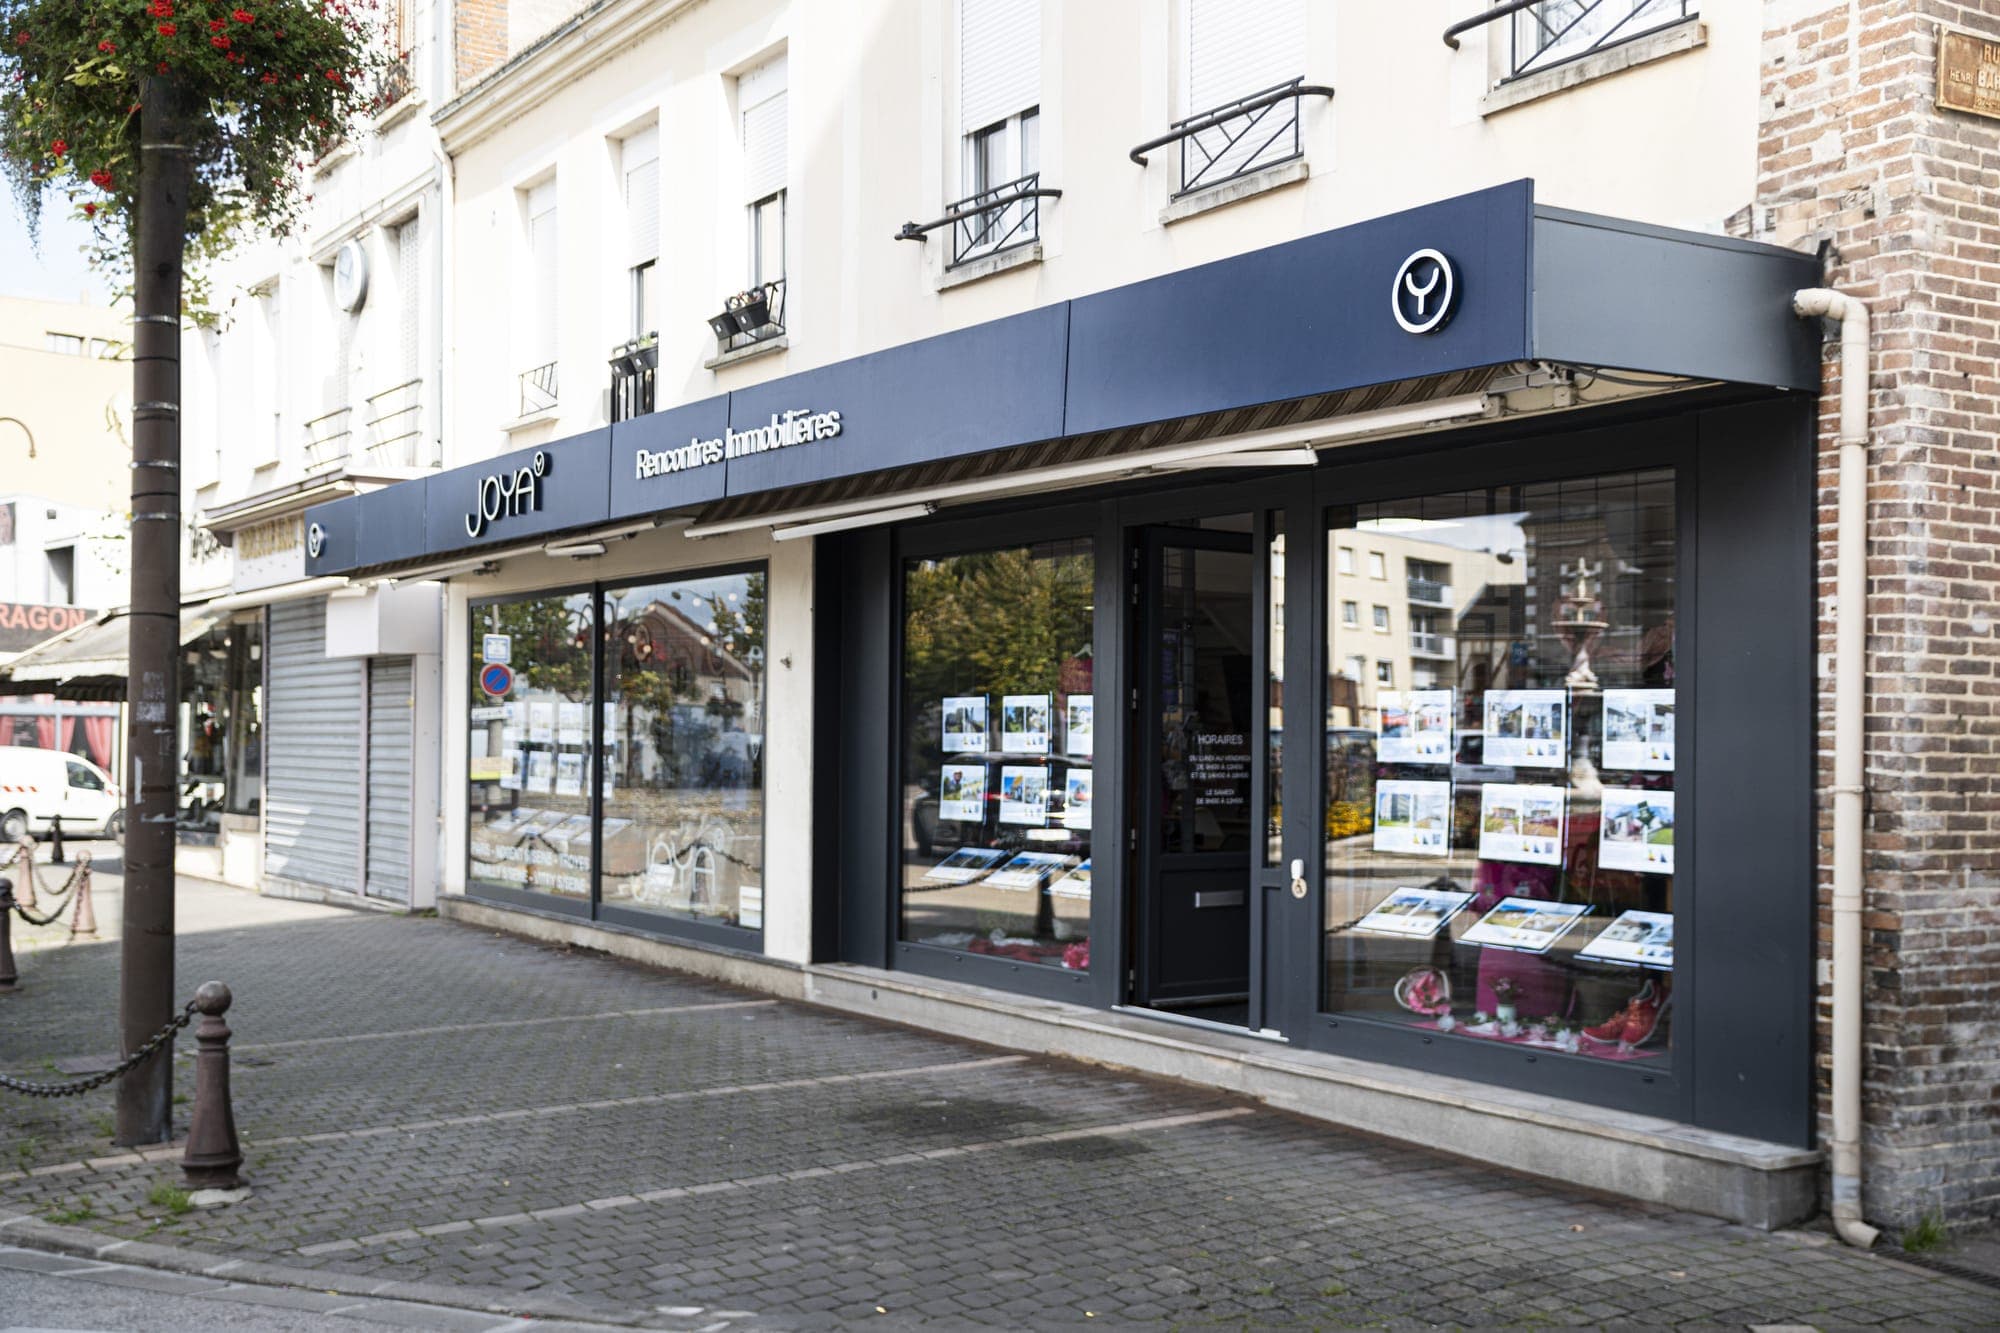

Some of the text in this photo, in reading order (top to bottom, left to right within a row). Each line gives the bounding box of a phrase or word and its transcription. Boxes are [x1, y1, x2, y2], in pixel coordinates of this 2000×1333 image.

[636, 408, 841, 480] Rencontres Immobilières
[465, 467, 534, 537] JOYA
[1198, 735, 1243, 745] HORAIRES
